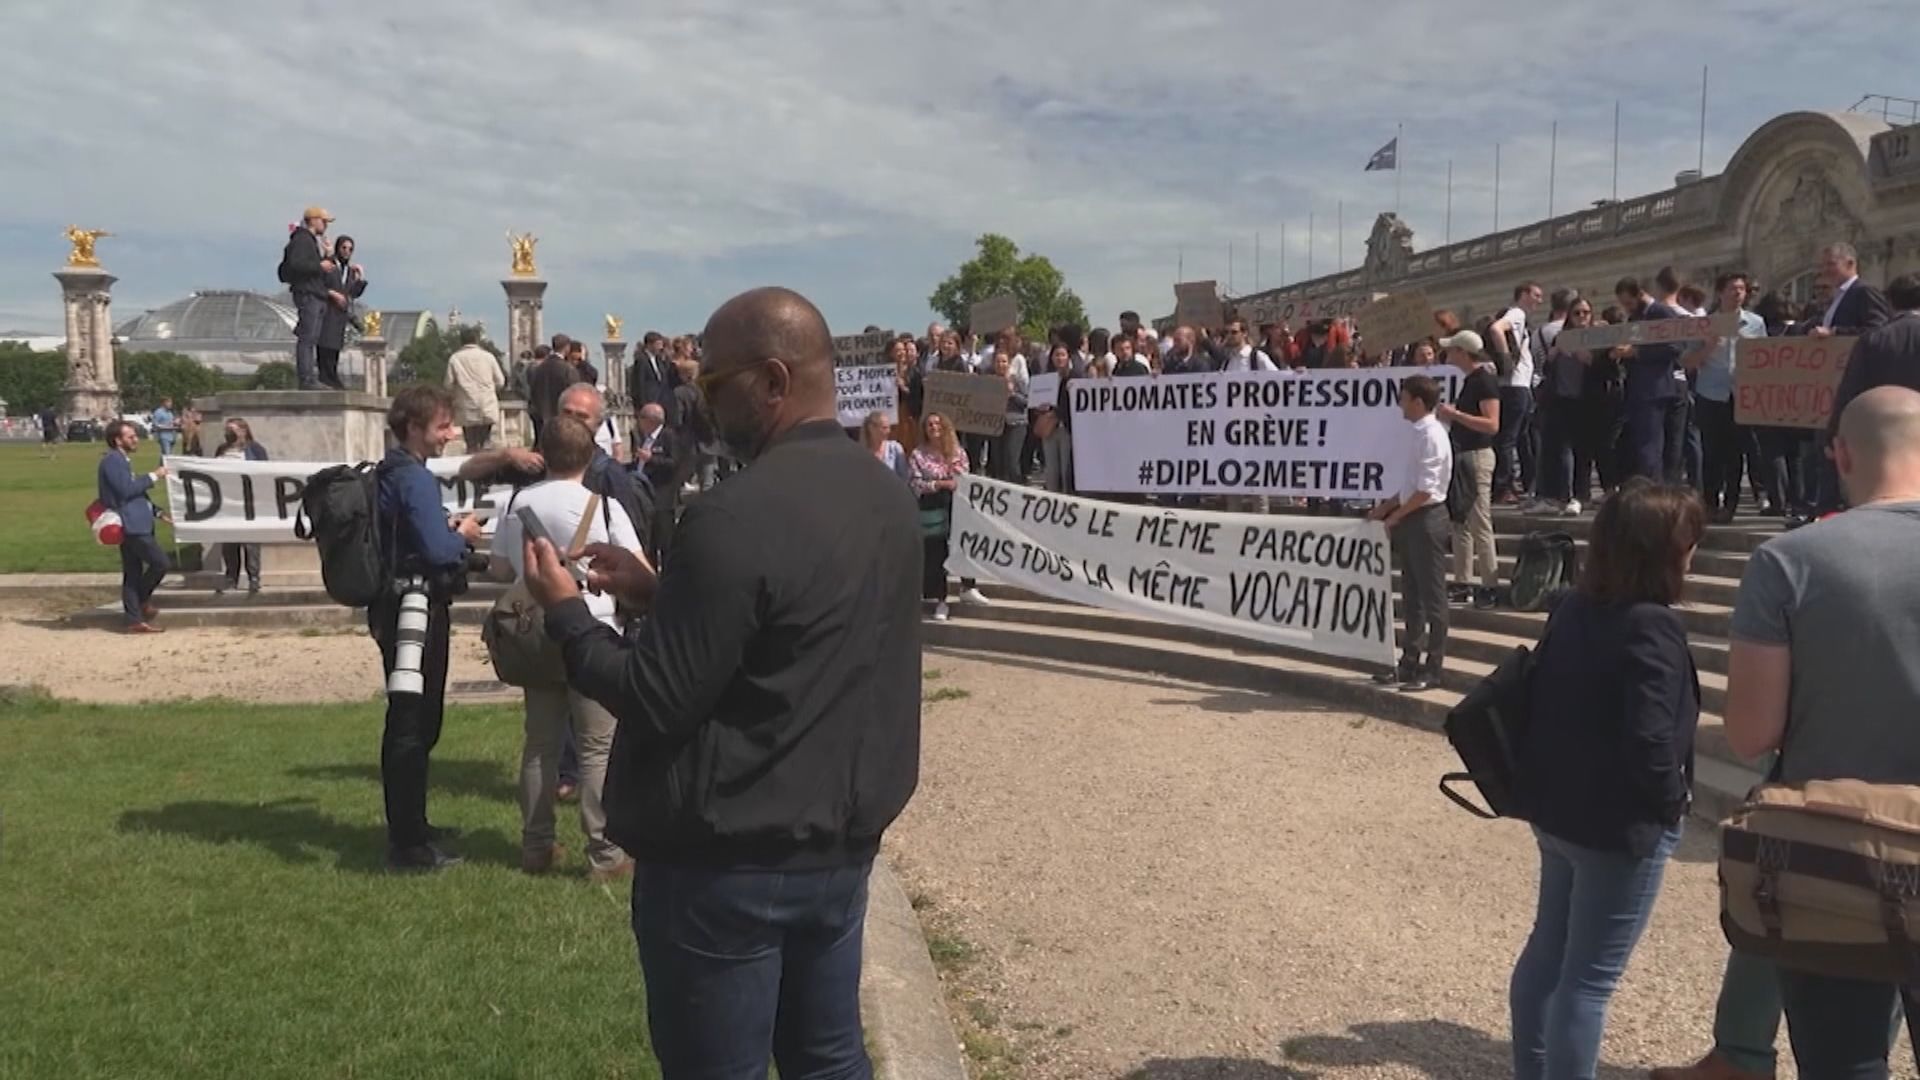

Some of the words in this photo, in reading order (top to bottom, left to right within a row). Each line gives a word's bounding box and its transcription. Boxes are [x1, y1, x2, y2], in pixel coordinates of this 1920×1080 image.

[838, 369, 854, 383] ES
[1835, 351, 1848, 369] E
[869, 381, 882, 393] LA
[1076, 381, 1217, 413] DIPLOMATES
[838, 396, 893, 411] IPLOMATIE
[1187, 420, 1215, 446] EN
[1225, 413, 1309, 447] GRÈVE
[1138, 459, 1384, 491] #DIPLO2METIER
[178, 470, 306, 521] DIP
[969, 482, 1010, 516] PAS
[1020, 494, 1080, 528] TOUS
[1088, 508, 1120, 537] LE
[1136, 511, 1221, 555] MÊME
[1240, 526, 1385, 576] PARCOURS
[960, 531, 1014, 566] MAIS
[1021, 542, 1074, 581] TOUS
[1083, 559, 1114, 591] LA
[1128, 560, 1210, 609] MÊME
[1229, 570, 1386, 643] VOCATION
